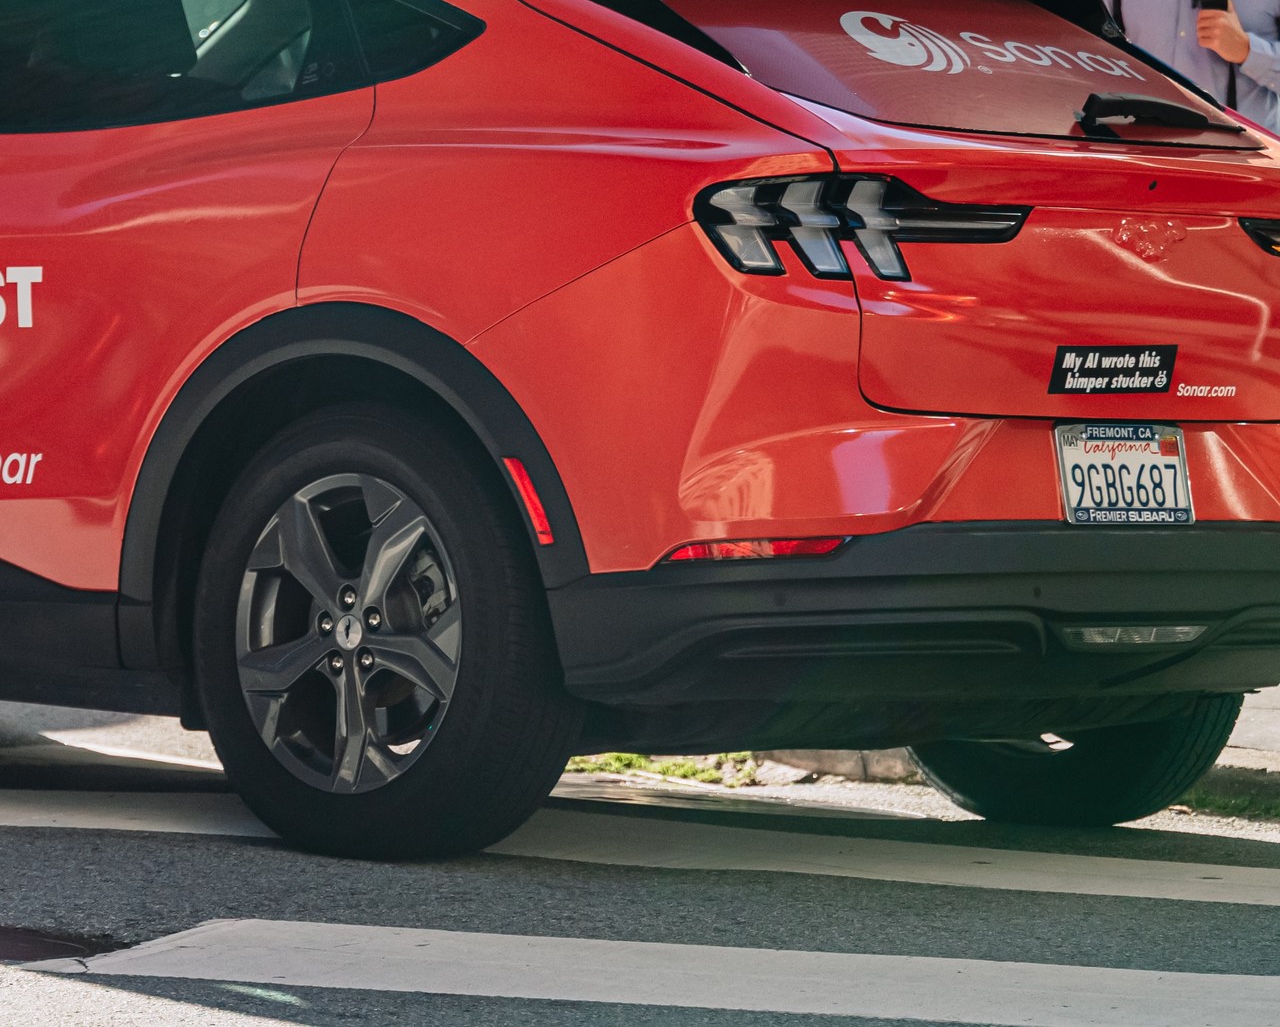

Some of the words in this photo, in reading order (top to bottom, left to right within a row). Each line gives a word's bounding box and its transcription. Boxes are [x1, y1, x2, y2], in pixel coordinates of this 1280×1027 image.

[959, 30, 1147, 81] Sonar
[1062, 352, 1083, 372] My
[1084, 353, 1099, 369] AI
[1101, 354, 1136, 369] wrote
[1138, 351, 1161, 368] this
[1064, 372, 1109, 393] bimper
[1110, 371, 1154, 389] stucker
[1176, 383, 1236, 398] Sonar.com
[1062, 434, 1079, 448] MAY
[1086, 427, 1136, 440] FREMONT,
[1138, 428, 1152, 439] CA
[1083, 440, 1160, 460] California
[1071, 463, 1178, 507] 9GBG687
[1089, 509, 1127, 522] PREMIER
[1128, 510, 1175, 522] SUBARU
